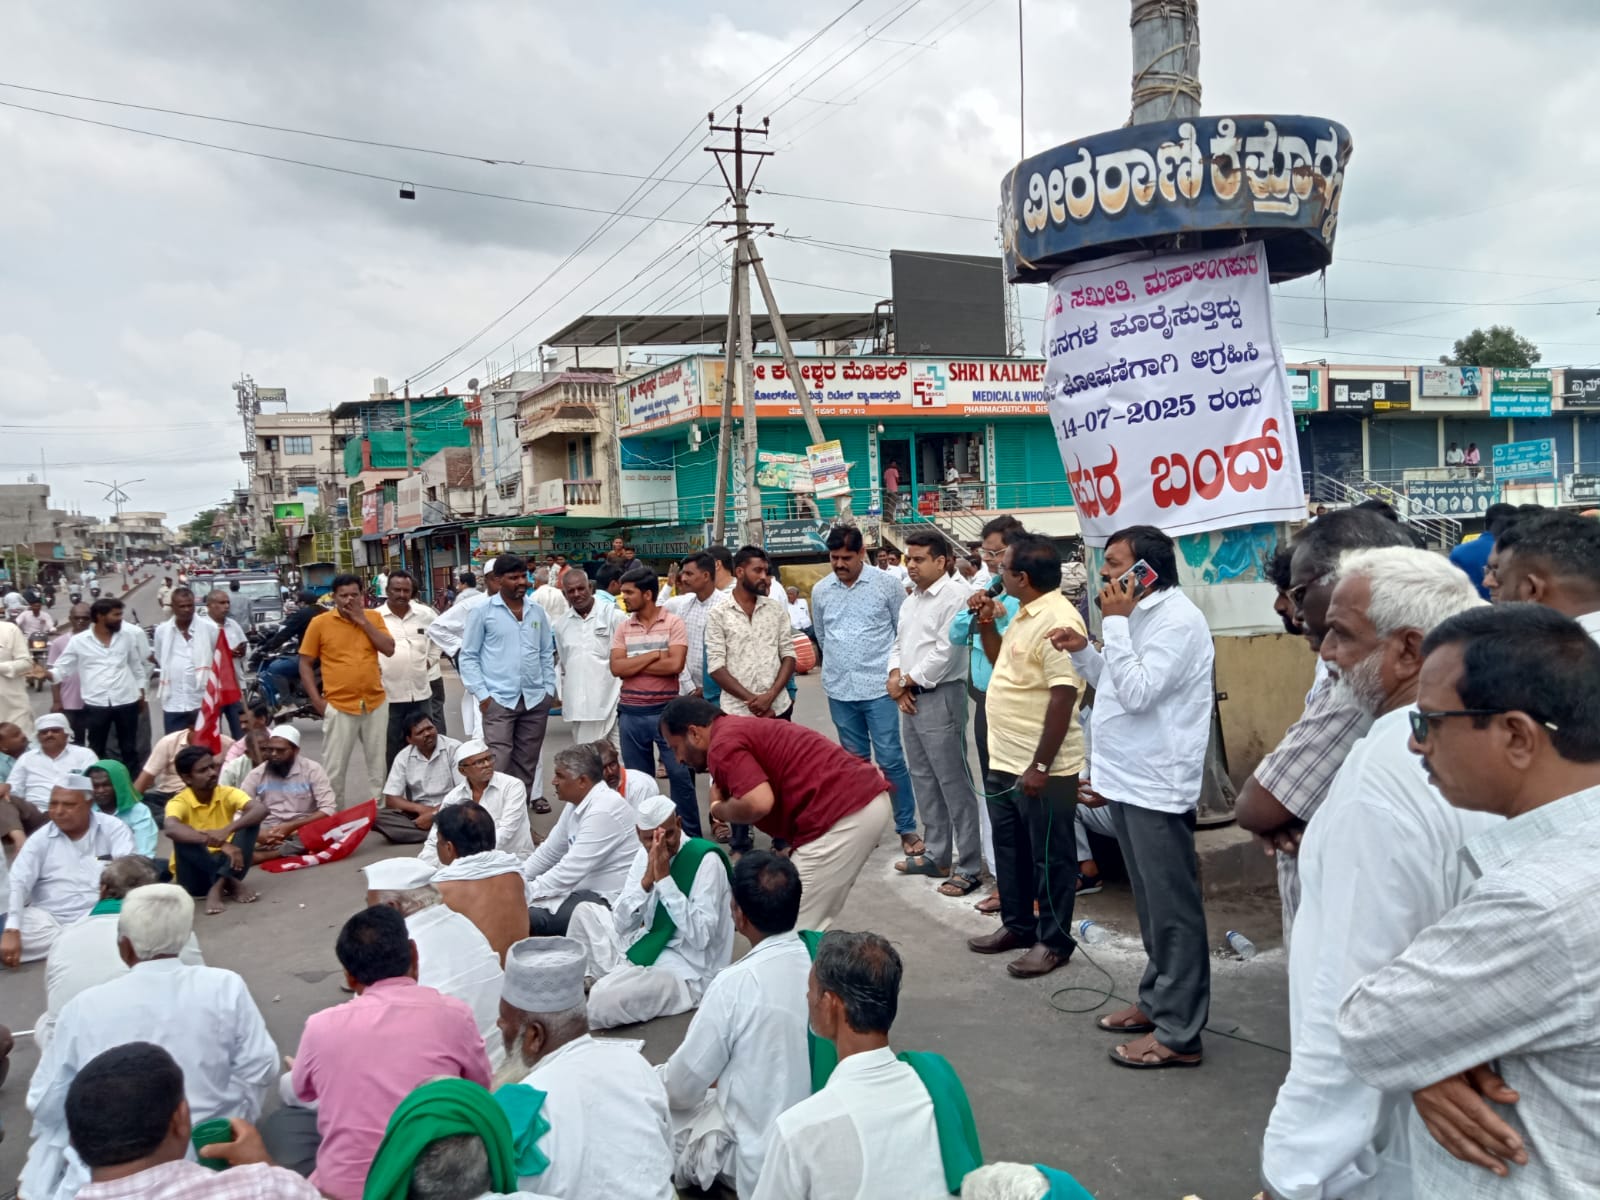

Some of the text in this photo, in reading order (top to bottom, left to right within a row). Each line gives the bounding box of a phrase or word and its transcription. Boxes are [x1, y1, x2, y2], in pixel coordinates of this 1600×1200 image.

[842, 360, 907, 380] ಮೆಡಿಕಲ್
[948, 362, 984, 382] SHRI
[972, 390, 1013, 402] MEDICAL
[1014, 391, 1020, 402] &
[1208, 383, 1262, 411] ರಂದು
[964, 405, 1031, 413] PHARMACEUTICAL
[1150, 417, 1284, 509] ಬಂದ್
